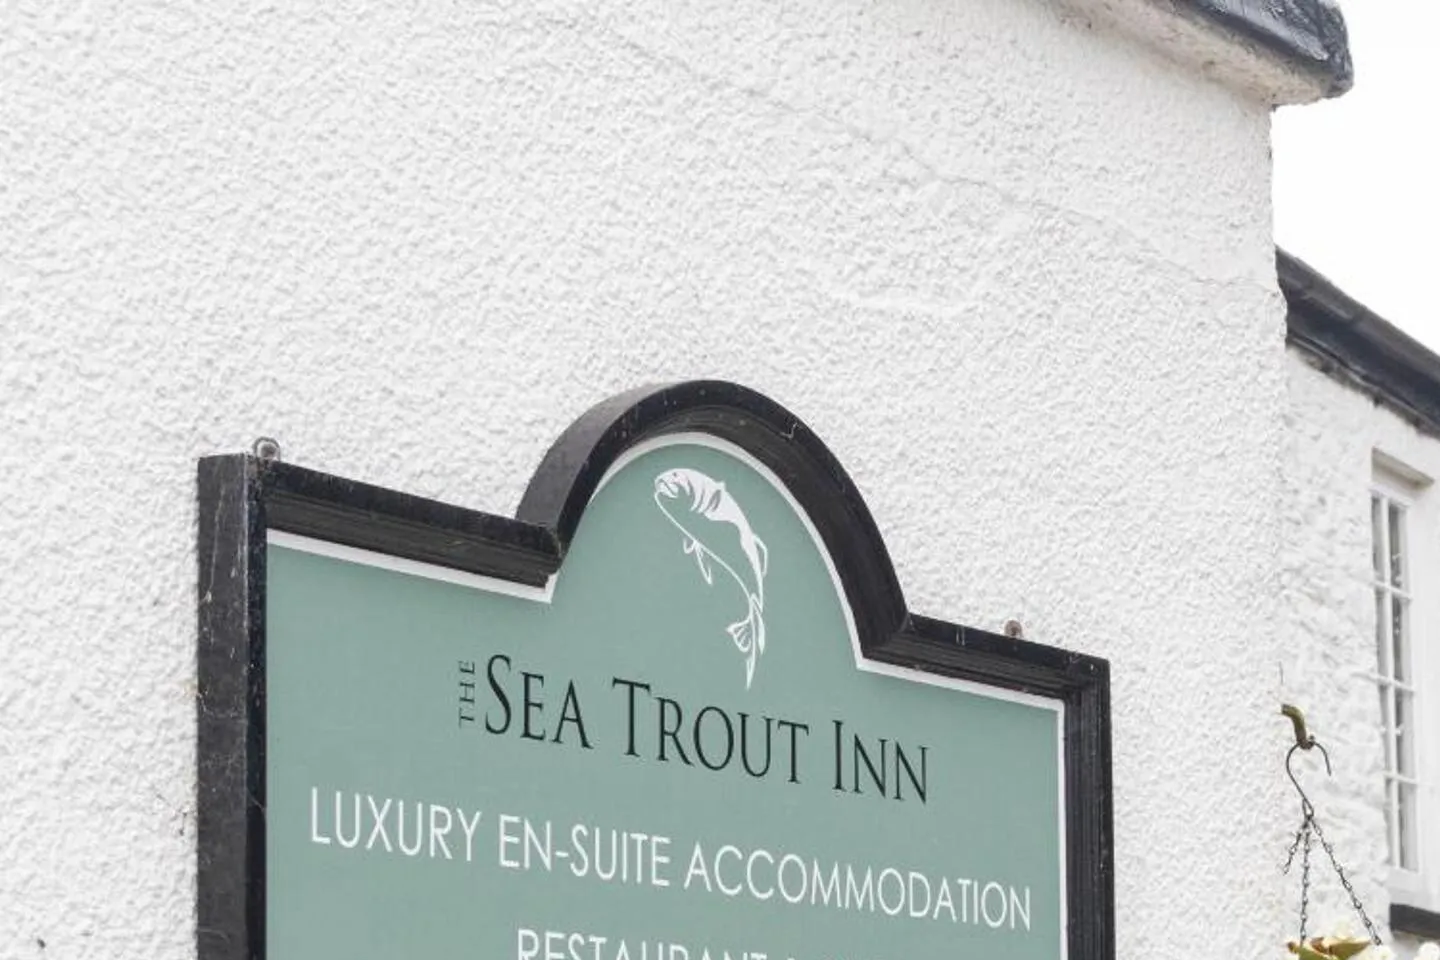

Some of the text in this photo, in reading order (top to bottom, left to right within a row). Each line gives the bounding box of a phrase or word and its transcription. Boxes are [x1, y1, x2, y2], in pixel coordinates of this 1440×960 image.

[457, 654, 929, 804] THE SEA TROUT INN
[310, 786, 1032, 931] LUXURY EN-SUITE ACCOMMODATION
